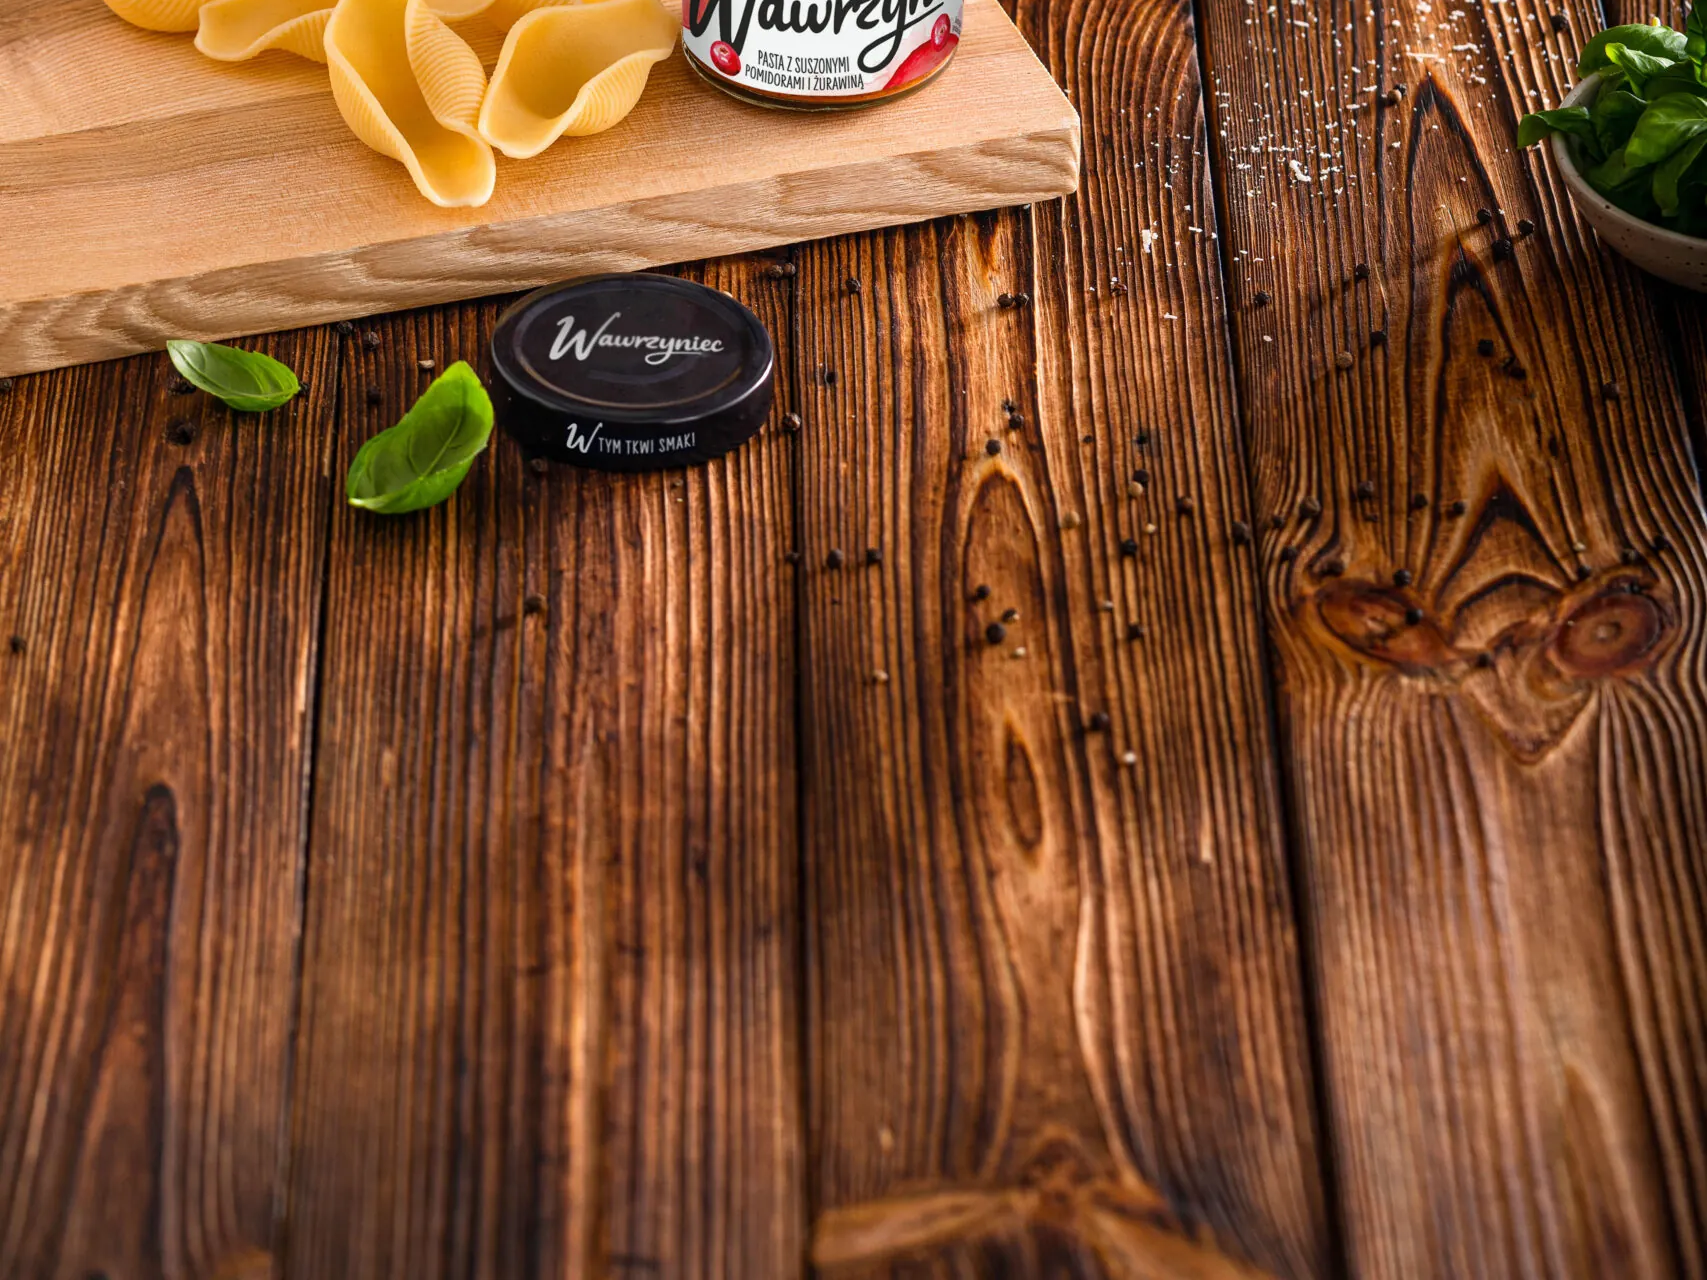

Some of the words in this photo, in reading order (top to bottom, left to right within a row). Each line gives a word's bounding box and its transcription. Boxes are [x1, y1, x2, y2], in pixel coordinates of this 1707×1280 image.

[757, 49, 785, 71] PASTA
[786, 55, 793, 72] Z
[794, 56, 850, 74] SUSZONYMI
[745, 64, 805, 90] POMIDORAMI
[807, 77, 811, 90] I
[813, 73, 865, 91] ŻURAWINĄ
[549, 312, 724, 365] Wawrzyniec
[566, 422, 603, 454] W
[598, 437, 621, 454] TYM
[625, 439, 654, 455] TKWI
[658, 431, 696, 453] SMAK!
